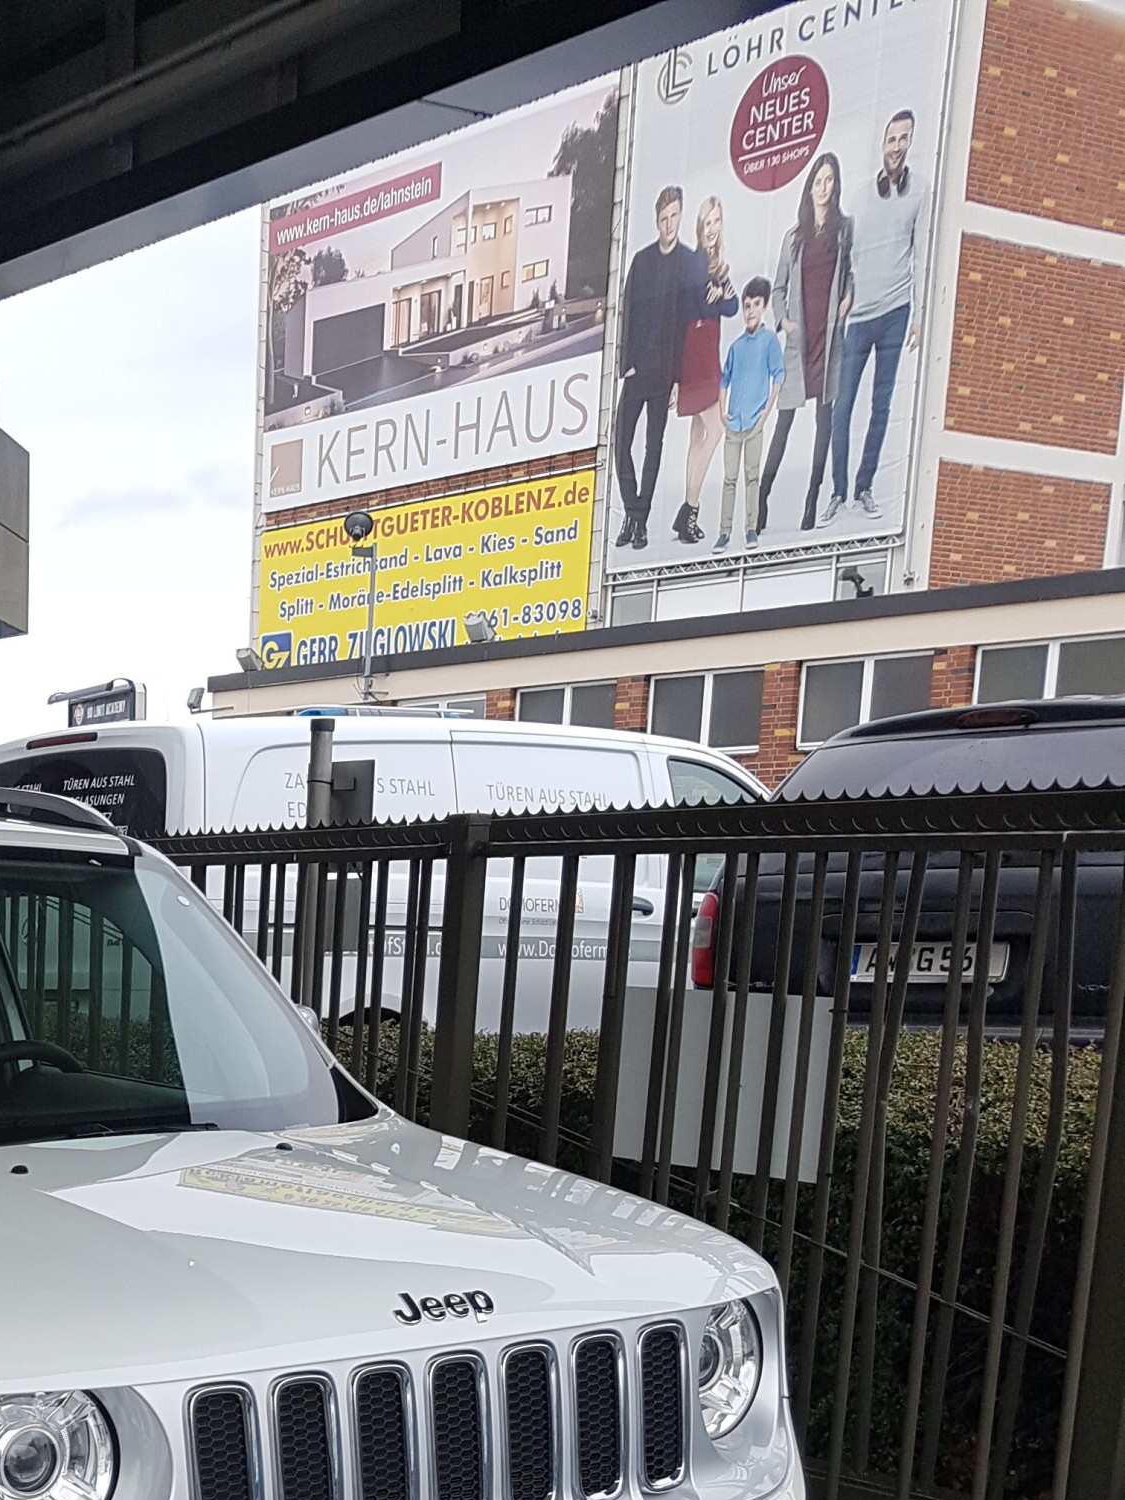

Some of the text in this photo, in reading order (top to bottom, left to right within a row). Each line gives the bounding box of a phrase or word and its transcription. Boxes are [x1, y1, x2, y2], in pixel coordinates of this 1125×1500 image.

[706, 26, 785, 77] LÖHR
[798, 0, 917, 42] CEN
[761, 65, 807, 98] Unser
[749, 87, 810, 126] NEUES
[742, 110, 815, 151] CENTER
[781, 145, 810, 164] SHOPS
[276, 176, 432, 246] www.kern-haus.de/lahnstein
[316, 372, 590, 489] KERN-HAUS
[264, 480, 590, 559] www.SCHUTGUETER-KOBLENZ.de
[425, 543, 462, 562] Lava
[481, 533, 515, 554] Kies
[534, 519, 578, 546] Sand
[279, 598, 314, 621] Splitt
[481, 560, 562, 588] Kalksplitt
[466, 598, 582, 628] 61-83098
[62, 774, 135, 792] TÜREN AUS STAHL
[389, 778, 435, 797] STAHL
[486, 781, 608, 808] TÜREN AUS STAHL
[392, 1290, 495, 1326] Jeep
